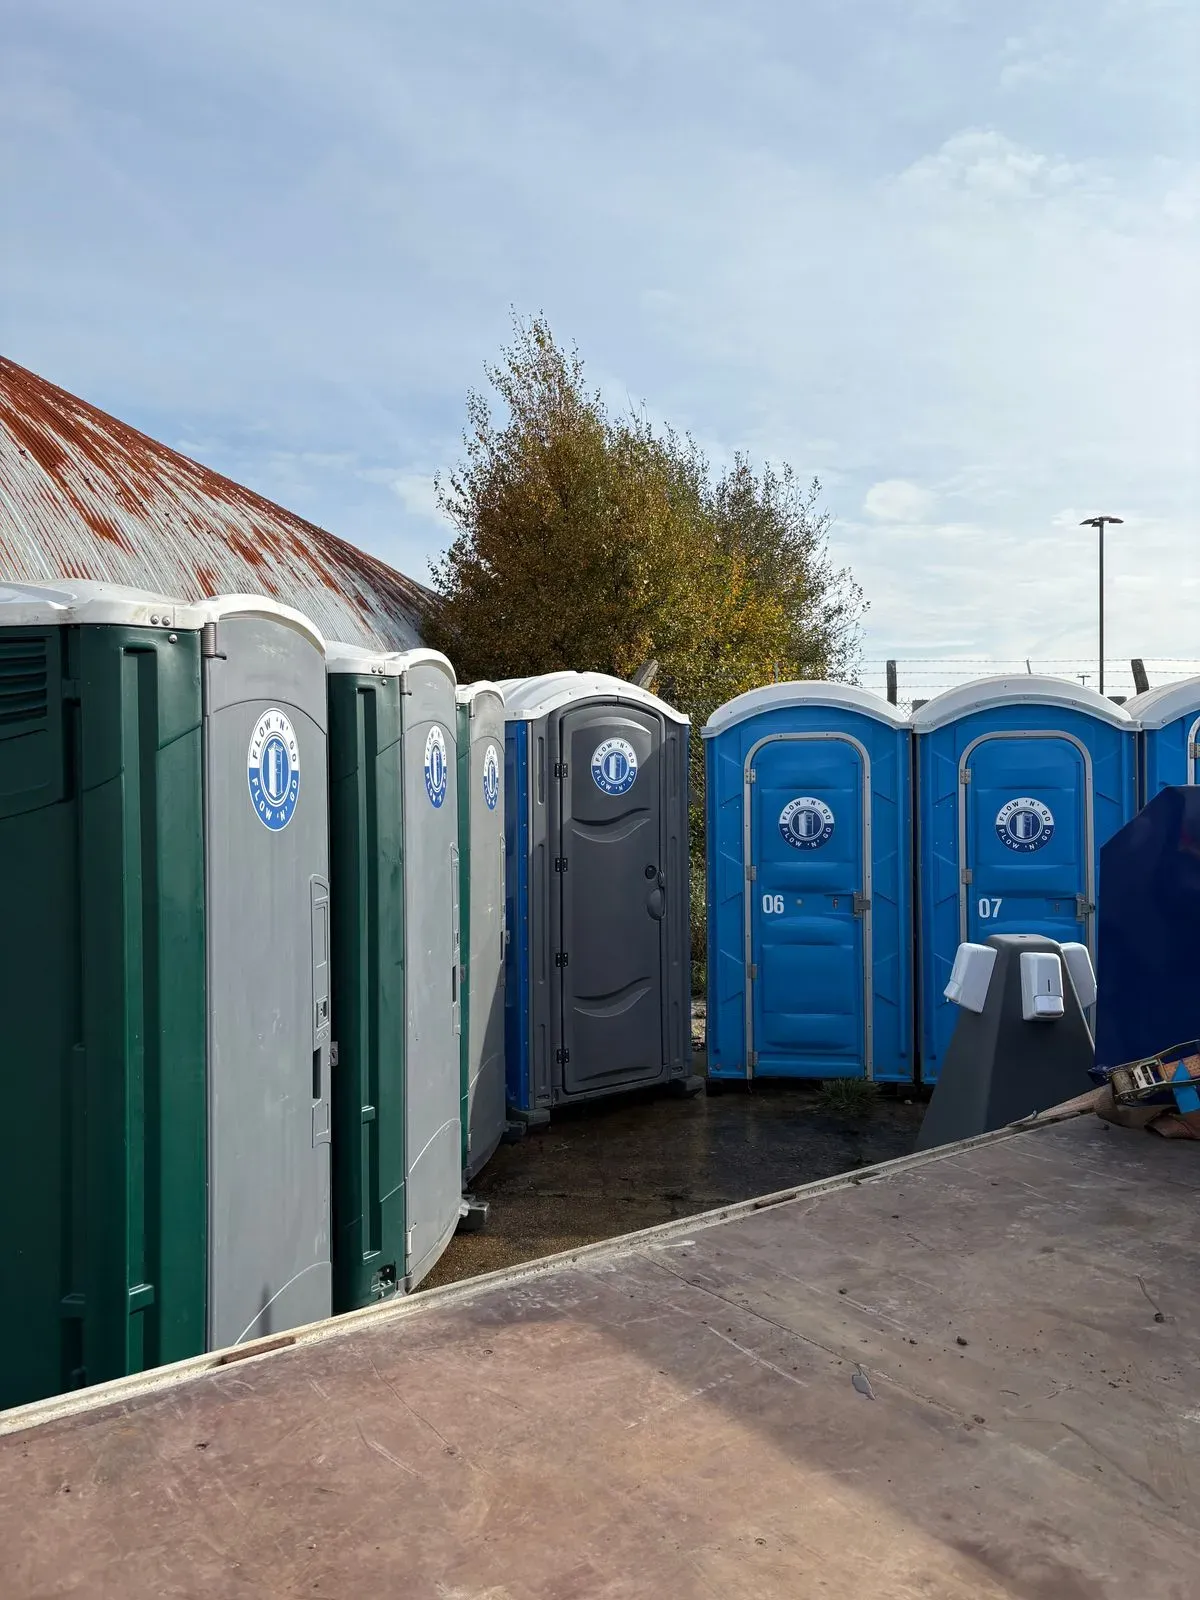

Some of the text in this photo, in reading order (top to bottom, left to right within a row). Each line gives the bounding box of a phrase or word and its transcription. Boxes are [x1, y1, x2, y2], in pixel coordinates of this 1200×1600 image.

[251, 717, 271, 760] FLOW
[290, 740, 297, 763] GO
[595, 742, 612, 763] FLOW
[594, 769, 612, 791] FLOW
[251, 777, 273, 821] FLOW
[290, 779, 297, 803] GO
[782, 800, 801, 821] FLOW
[822, 808, 832, 819] GO
[998, 801, 1019, 822] FLOW
[1041, 810, 1051, 822] GO
[782, 827, 802, 847] FLOW
[822, 827, 832, 839] GO
[998, 828, 1020, 849] FLOW
[1041, 829, 1051, 841] GO
[762, 894, 784, 914] 06
[978, 898, 1002, 919] 07
